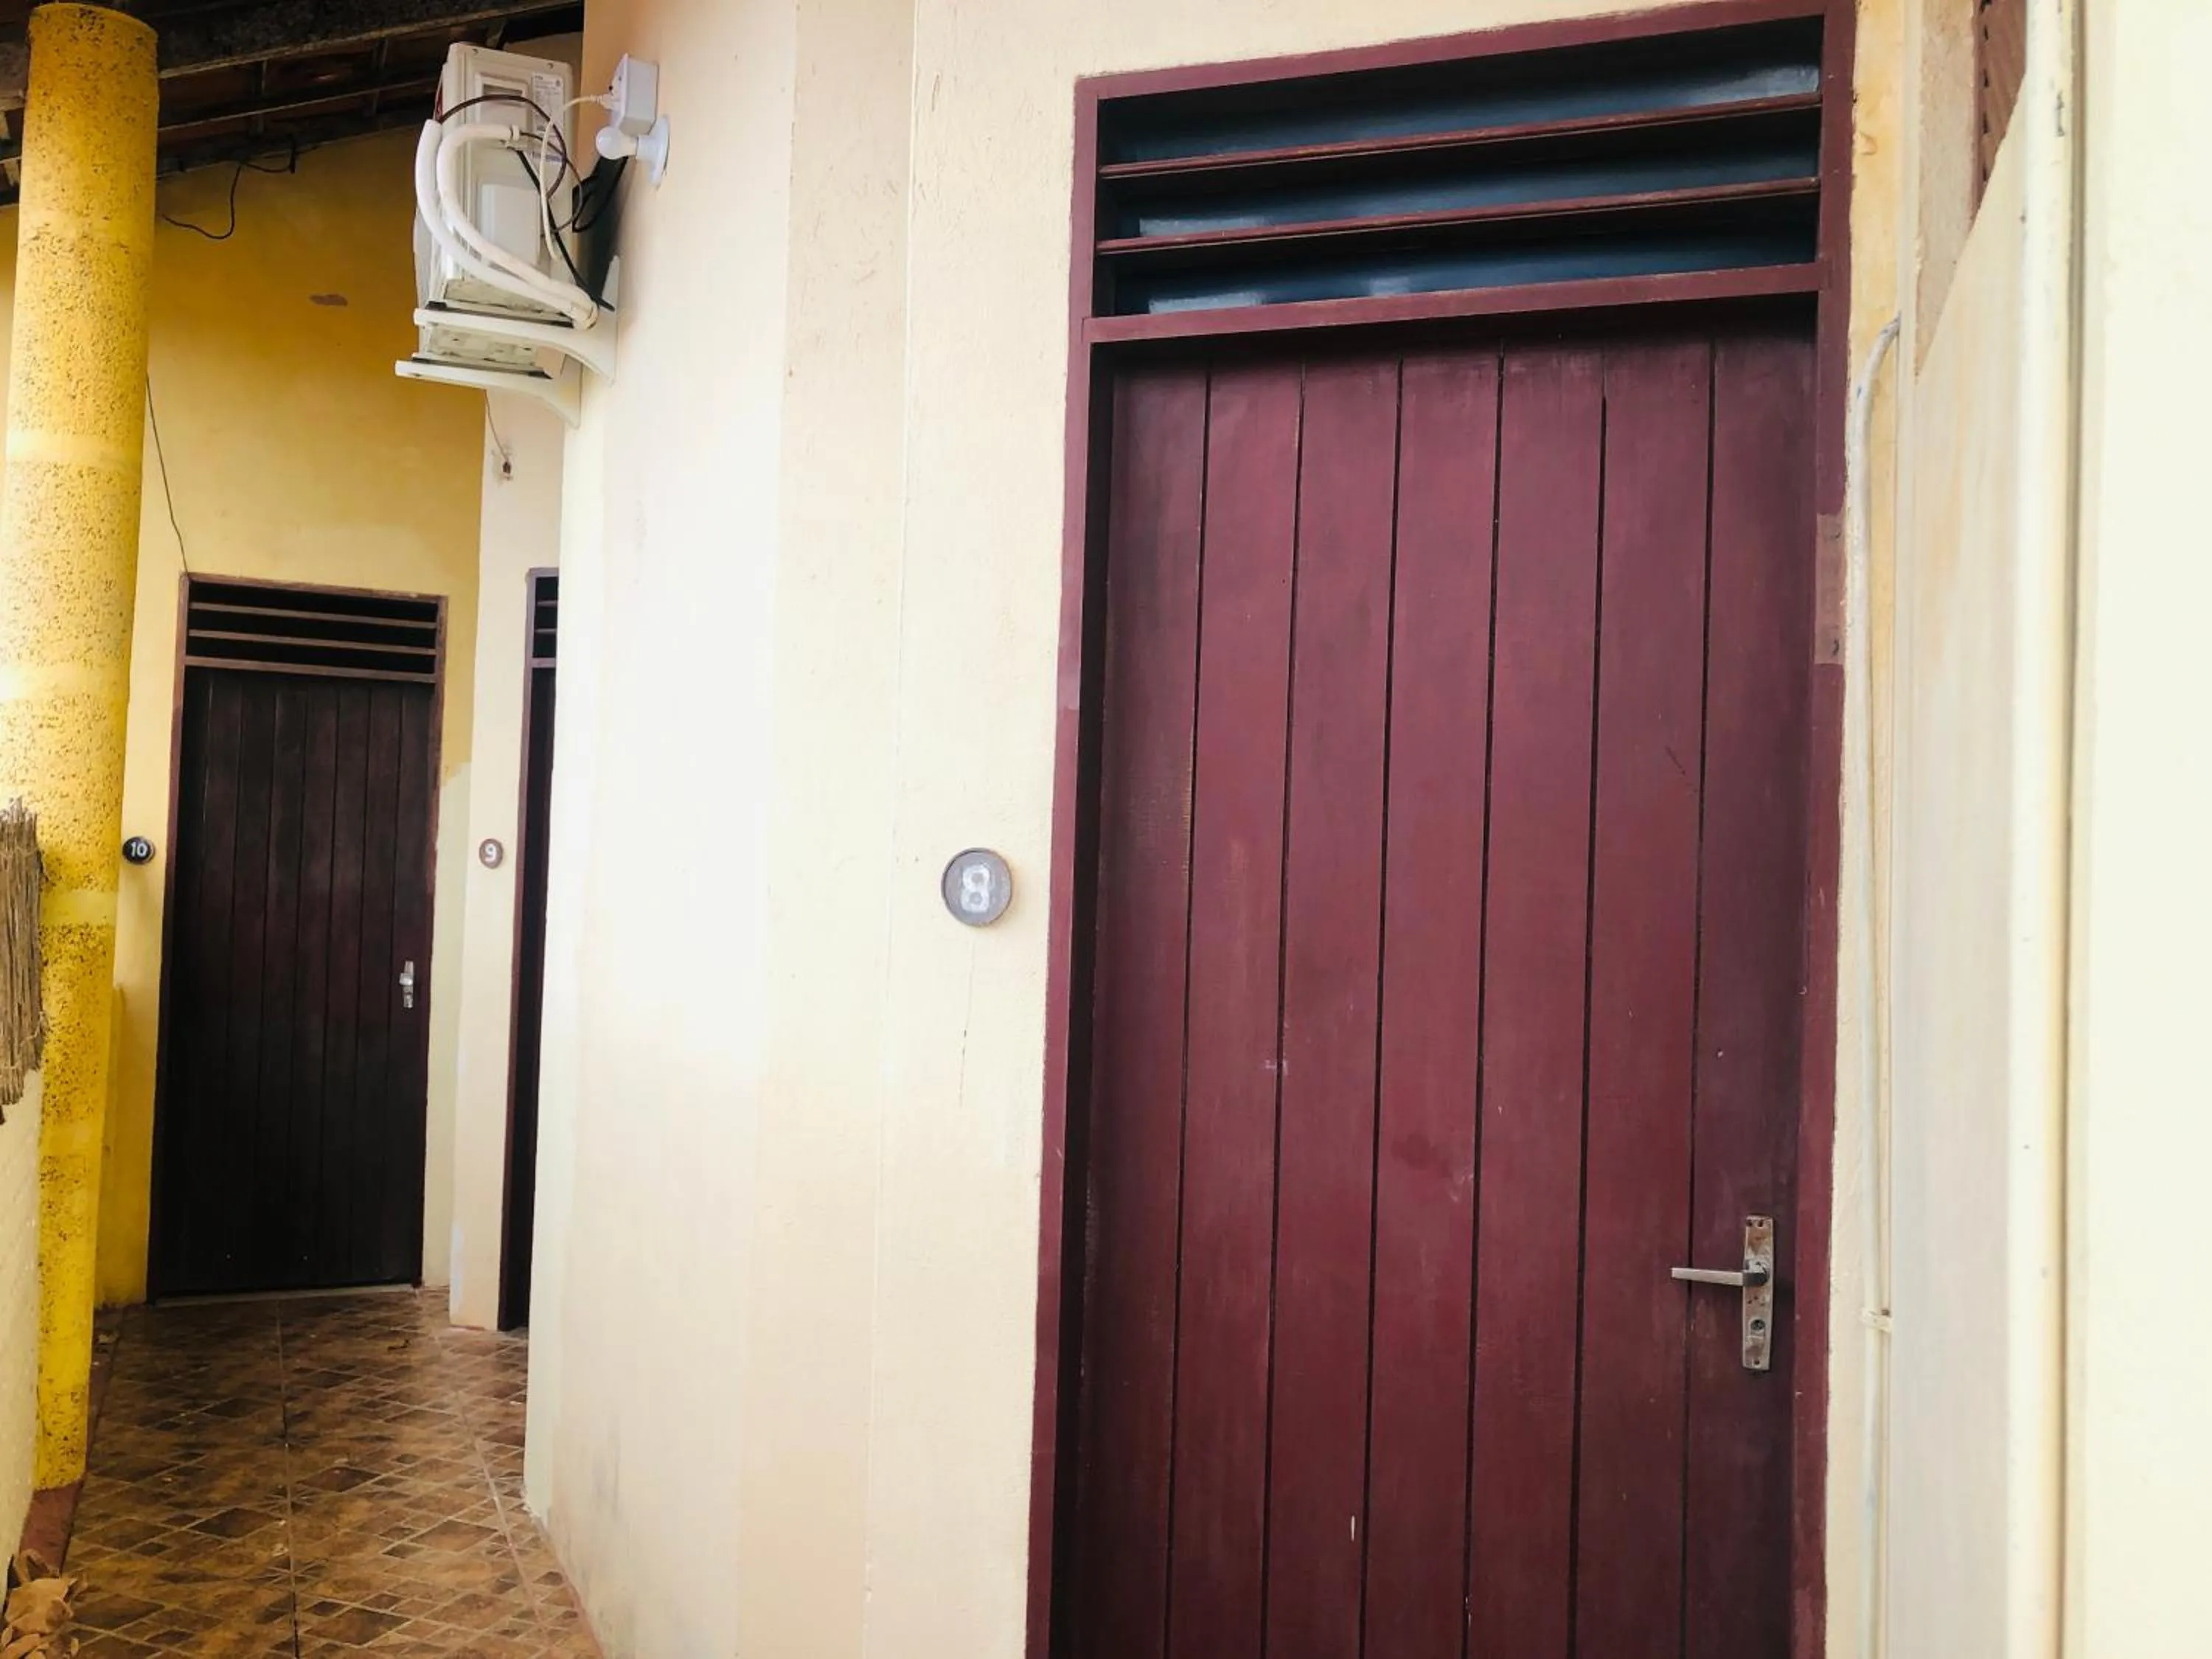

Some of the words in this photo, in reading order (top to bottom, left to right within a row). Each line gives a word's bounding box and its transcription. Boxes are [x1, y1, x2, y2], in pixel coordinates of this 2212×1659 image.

[131, 841, 147, 857] 10
[484, 843, 496, 862] 9
[961, 865, 990, 912] 8
